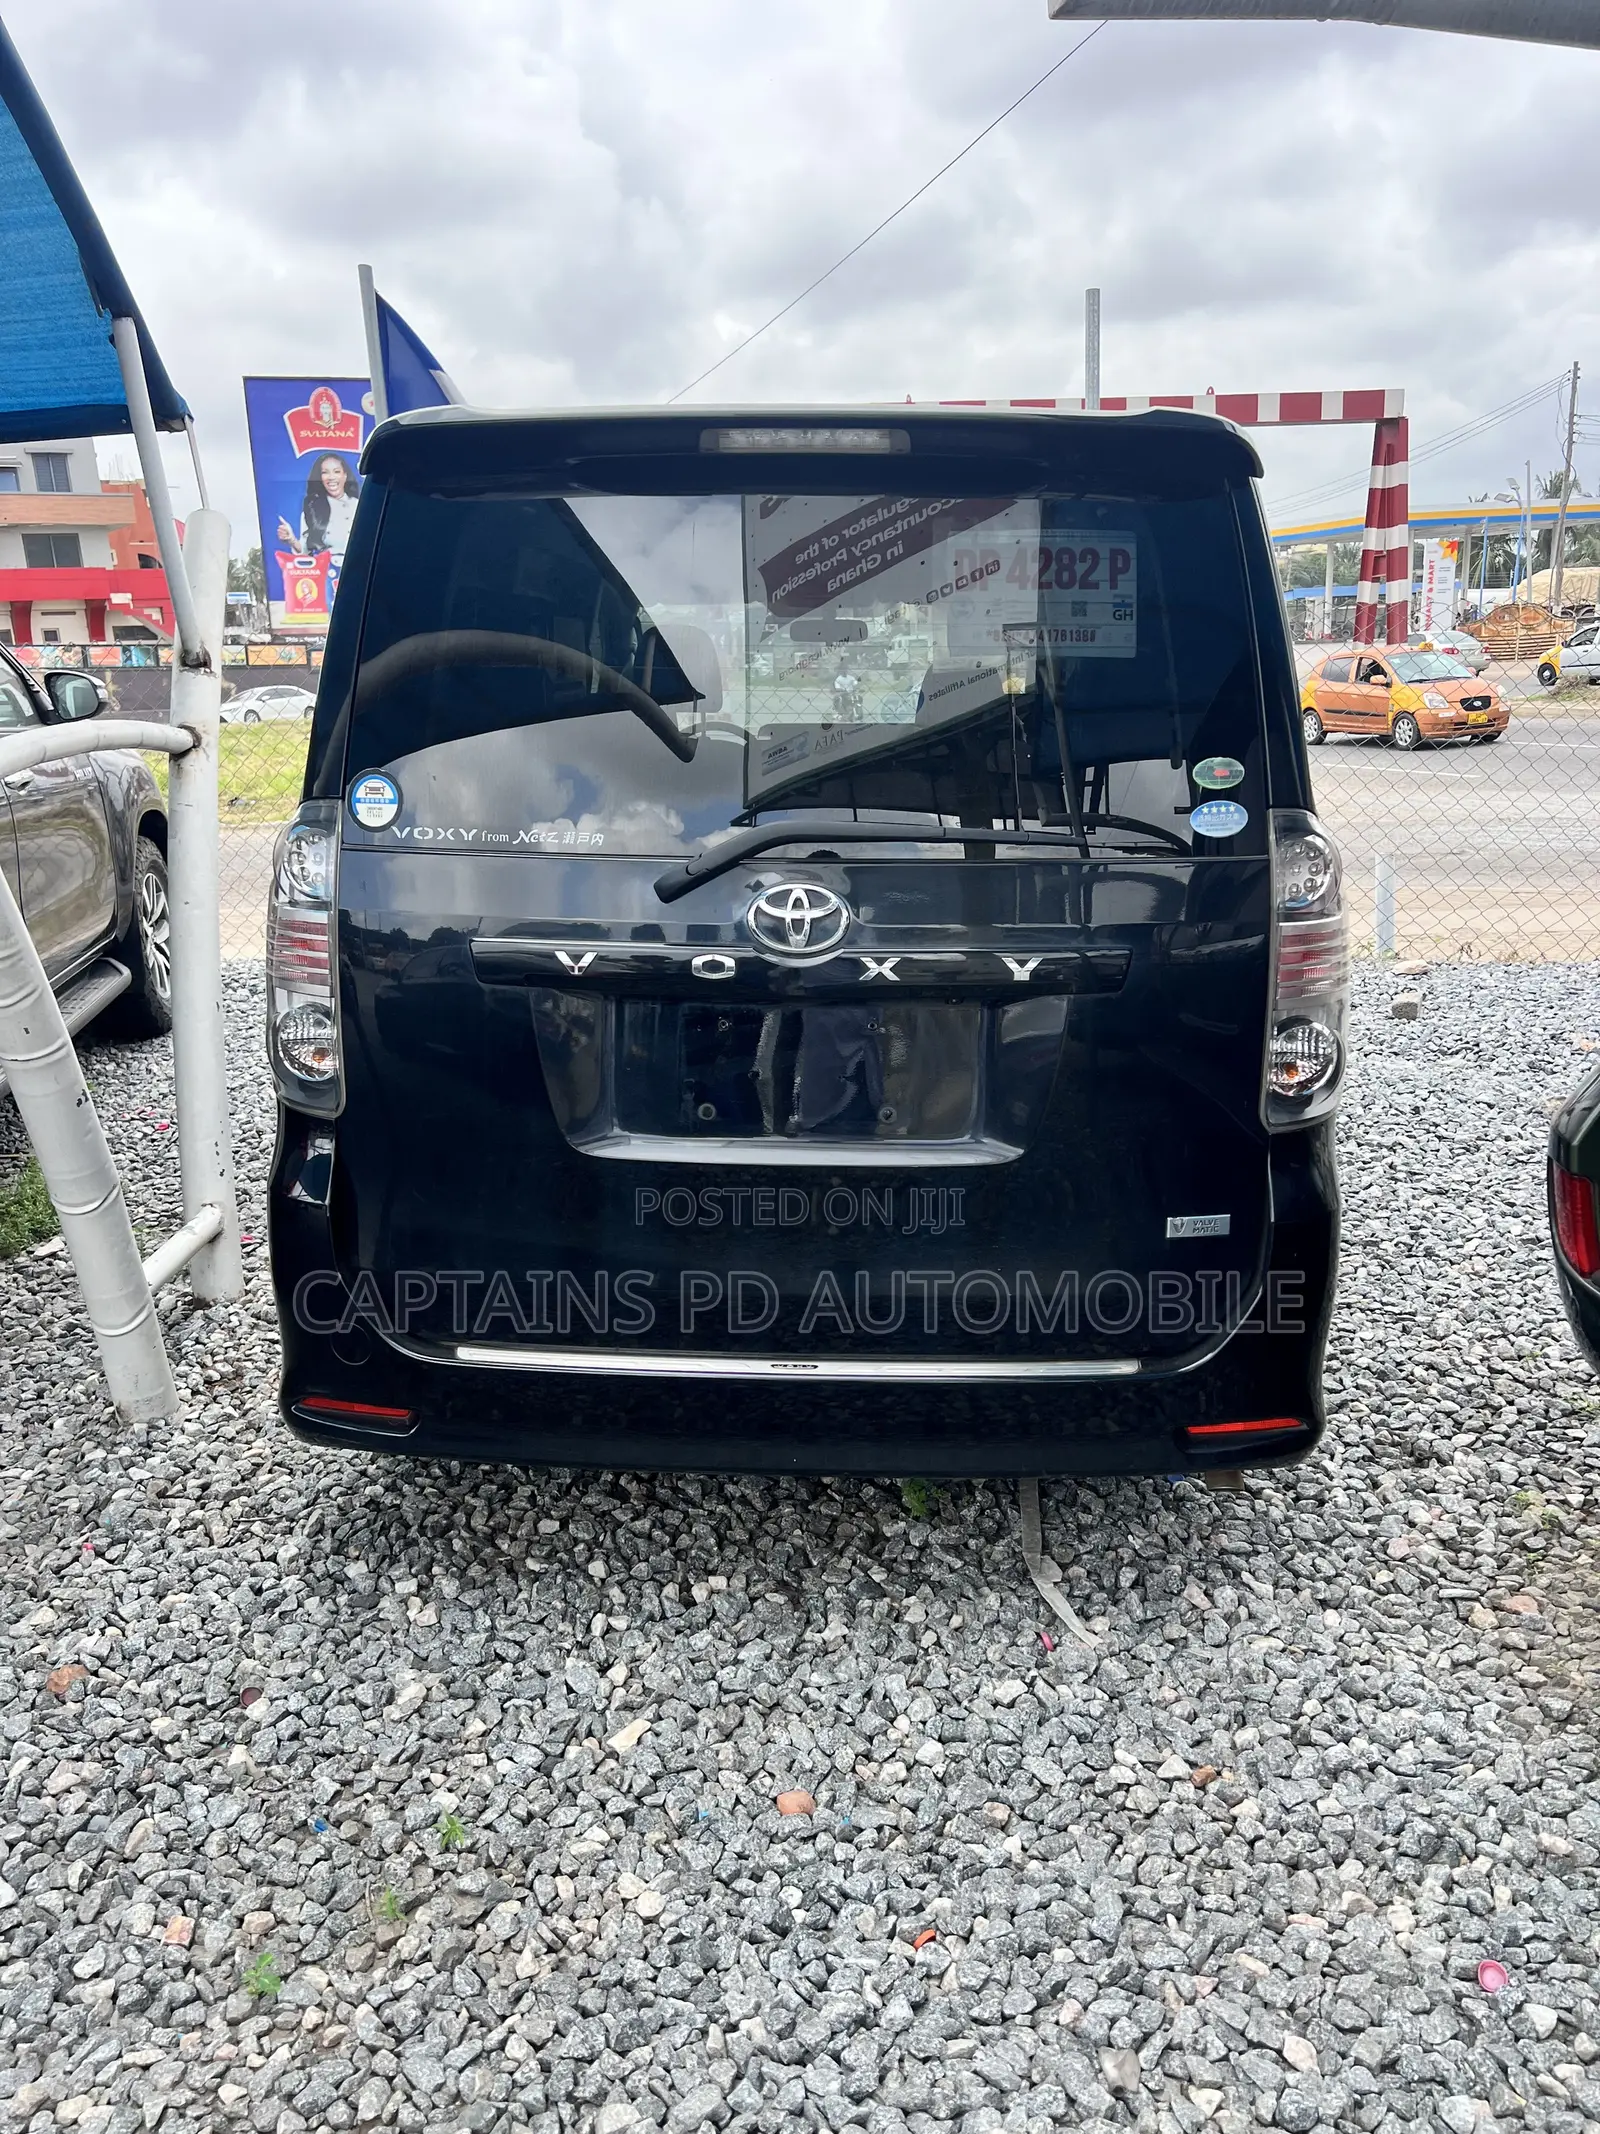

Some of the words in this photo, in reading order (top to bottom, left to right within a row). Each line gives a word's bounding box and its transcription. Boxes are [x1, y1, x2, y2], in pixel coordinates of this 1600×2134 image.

[954, 549, 999, 592] DP
[1006, 547, 1100, 590] 4282
[1109, 548, 1131, 590] P
[1427, 560, 1436, 585] MART
[1113, 609, 1134, 621] GH
[391, 826, 478, 841] VOXY
[481, 831, 509, 842] from
[554, 950, 1044, 981] VOXY
[1192, 1219, 1220, 1227] VALVE
[1192, 1226, 1220, 1234] MATIC
